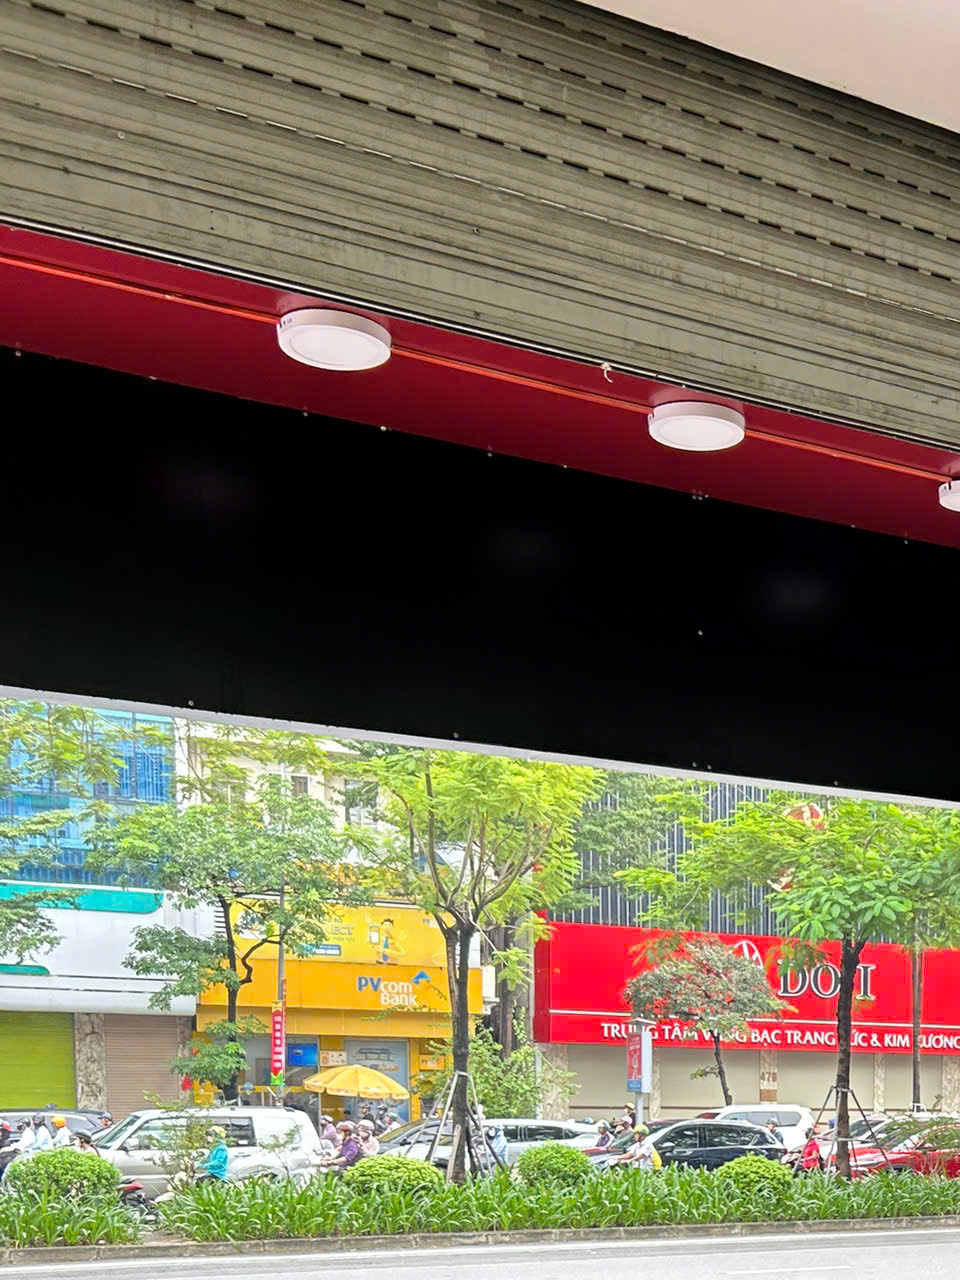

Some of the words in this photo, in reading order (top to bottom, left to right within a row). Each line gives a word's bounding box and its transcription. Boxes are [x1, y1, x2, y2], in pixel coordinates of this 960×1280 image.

[357, 976, 413, 993] PVcom
[777, 960, 876, 1000] DOI
[380, 992, 417, 1006] Bank
[751, 1028, 782, 1047] BẠC
[785, 1029, 836, 1046] TRANG
[870, 1033, 882, 1048] &
[884, 1033, 910, 1048] KIM
